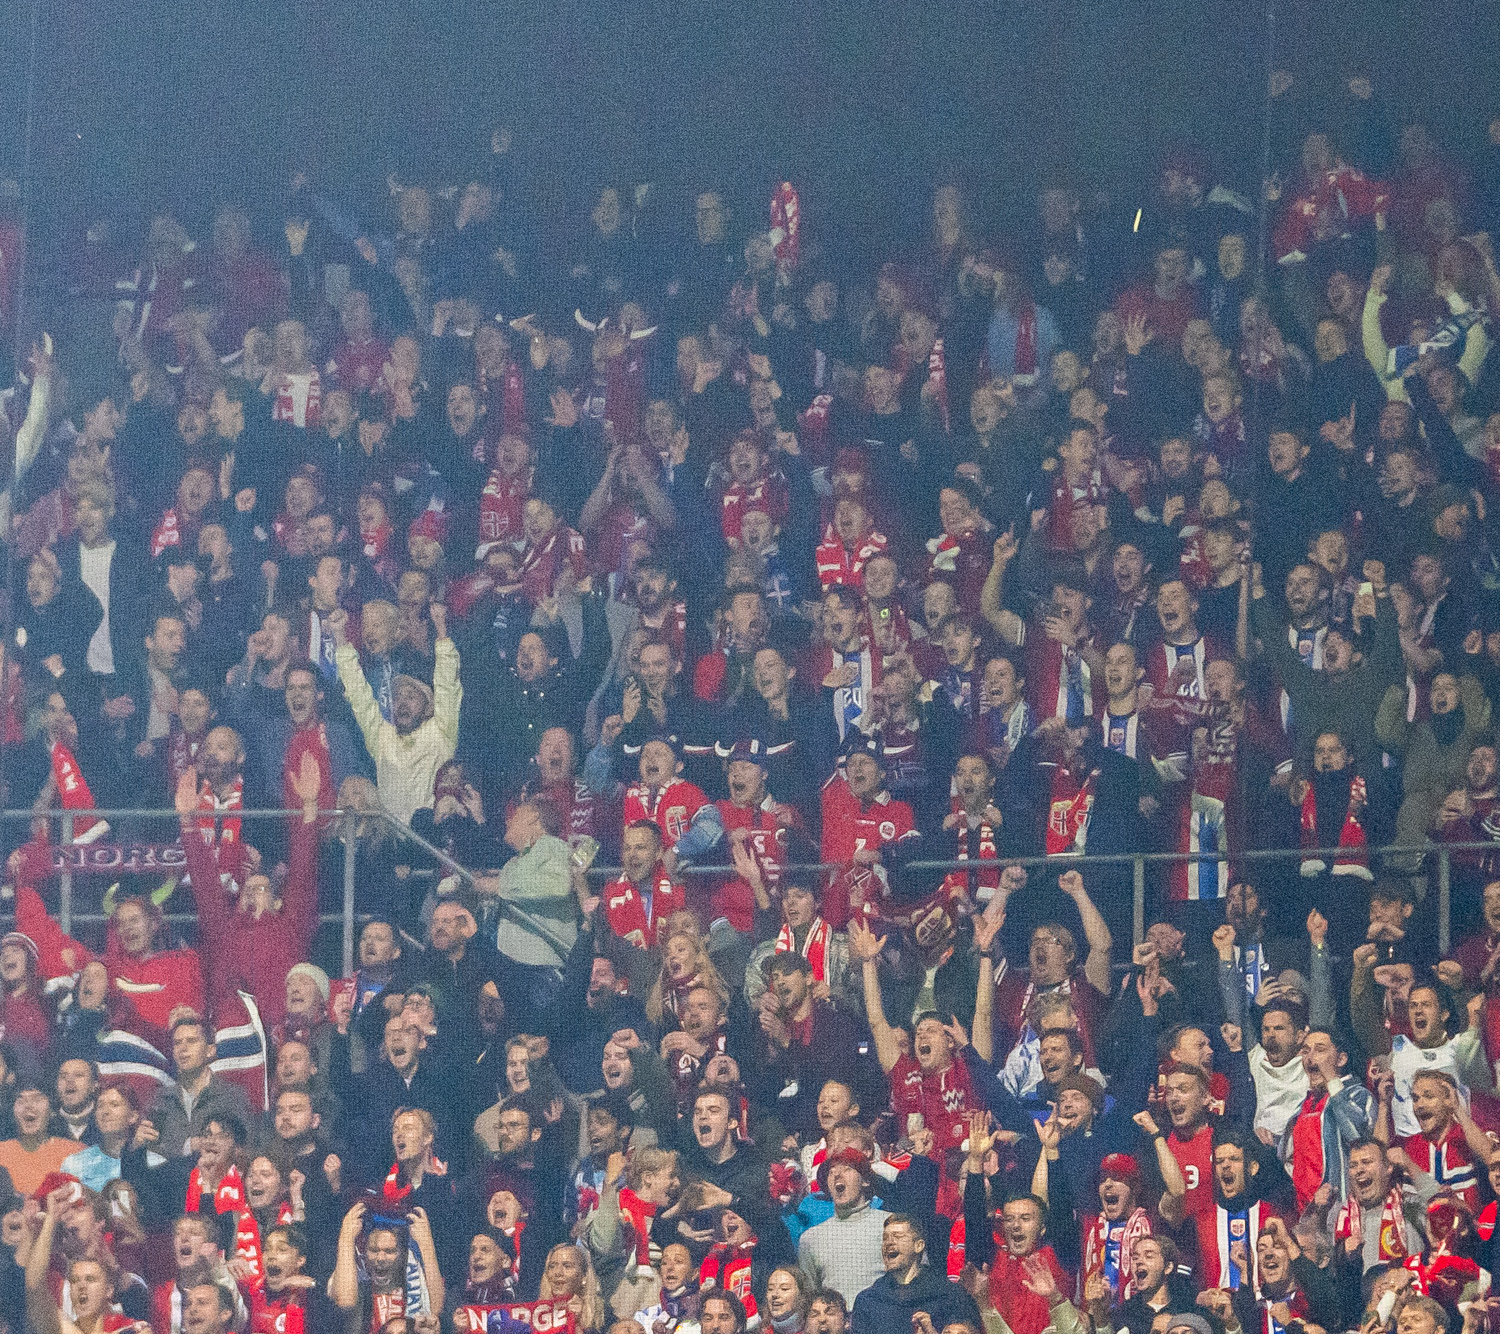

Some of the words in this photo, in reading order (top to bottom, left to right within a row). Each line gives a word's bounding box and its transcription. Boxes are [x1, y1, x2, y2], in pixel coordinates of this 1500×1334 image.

[53, 845, 187, 870] NORG
[1185, 1164, 1199, 1190] 3
[467, 1303, 568, 1334] NRGE
